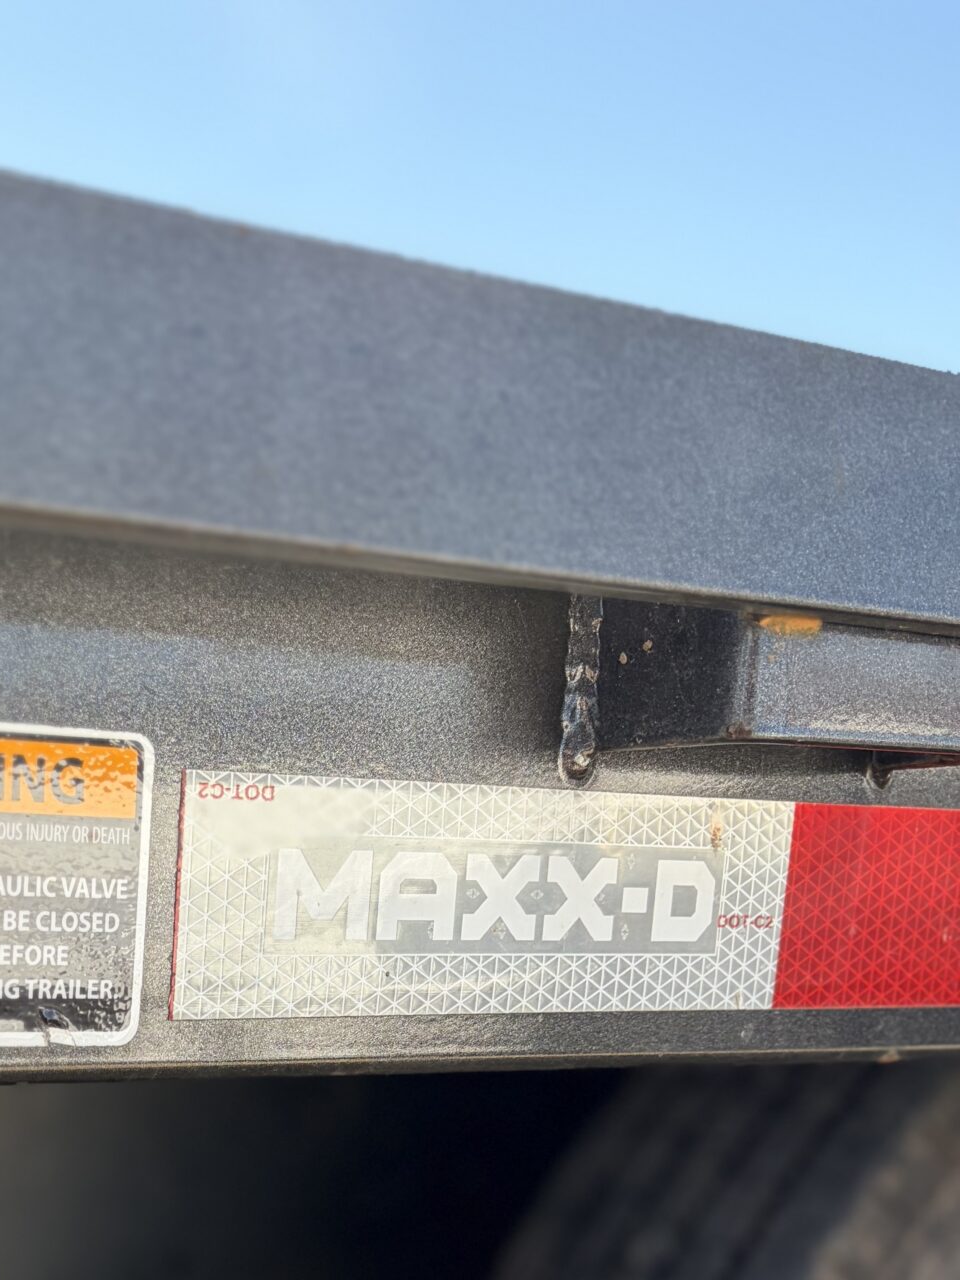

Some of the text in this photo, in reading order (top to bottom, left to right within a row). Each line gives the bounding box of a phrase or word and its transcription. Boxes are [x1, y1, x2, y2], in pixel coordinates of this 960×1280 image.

[198, 782, 275, 801] DOT-C2
[26, 823, 70, 842] INJURY
[72, 825, 89, 843] OR
[92, 827, 130, 845] DEATH
[61, 877, 129, 899] VALVE
[273, 848, 716, 942] MAXX-D
[3, 909, 30, 931] BE
[35, 911, 120, 932] CLOSED
[717, 914, 774, 928] DOT-C2
